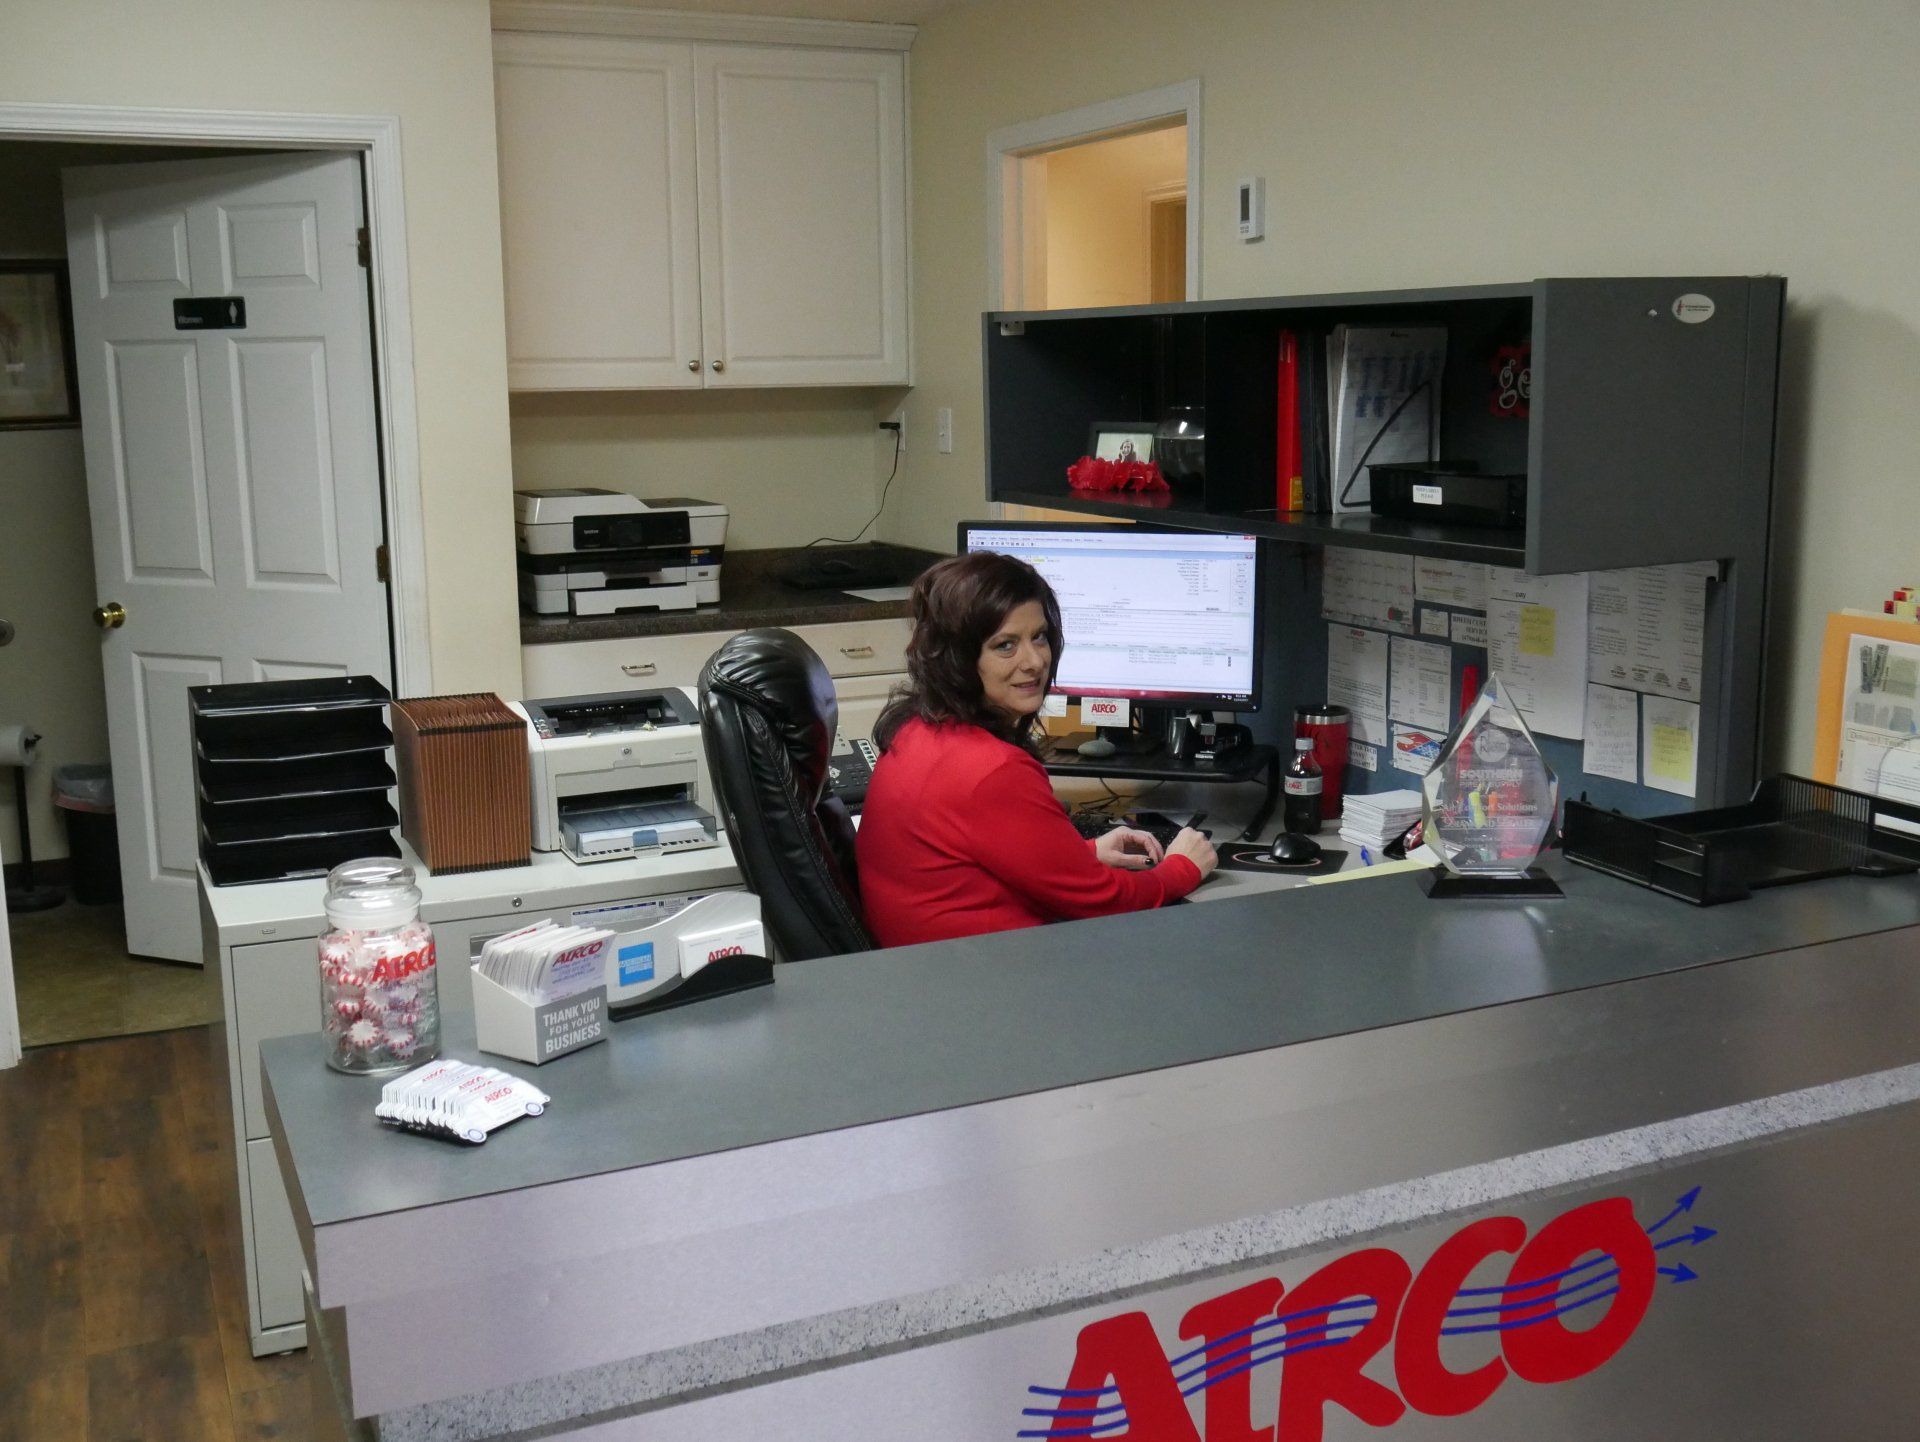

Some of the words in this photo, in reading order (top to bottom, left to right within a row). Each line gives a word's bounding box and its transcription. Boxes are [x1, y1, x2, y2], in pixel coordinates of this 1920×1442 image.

[1091, 703, 1117, 714] AIRCO
[553, 940, 603, 968] AIRCO
[543, 1004, 579, 1027] THANK
[581, 997, 600, 1014] YOU
[549, 1021, 569, 1036] FOR
[571, 1013, 595, 1029] YOUR
[545, 1022, 601, 1054] BUSINESS
[484, 1086, 513, 1104] AIRCO
[1046, 1197, 1657, 1442] AIRCO
